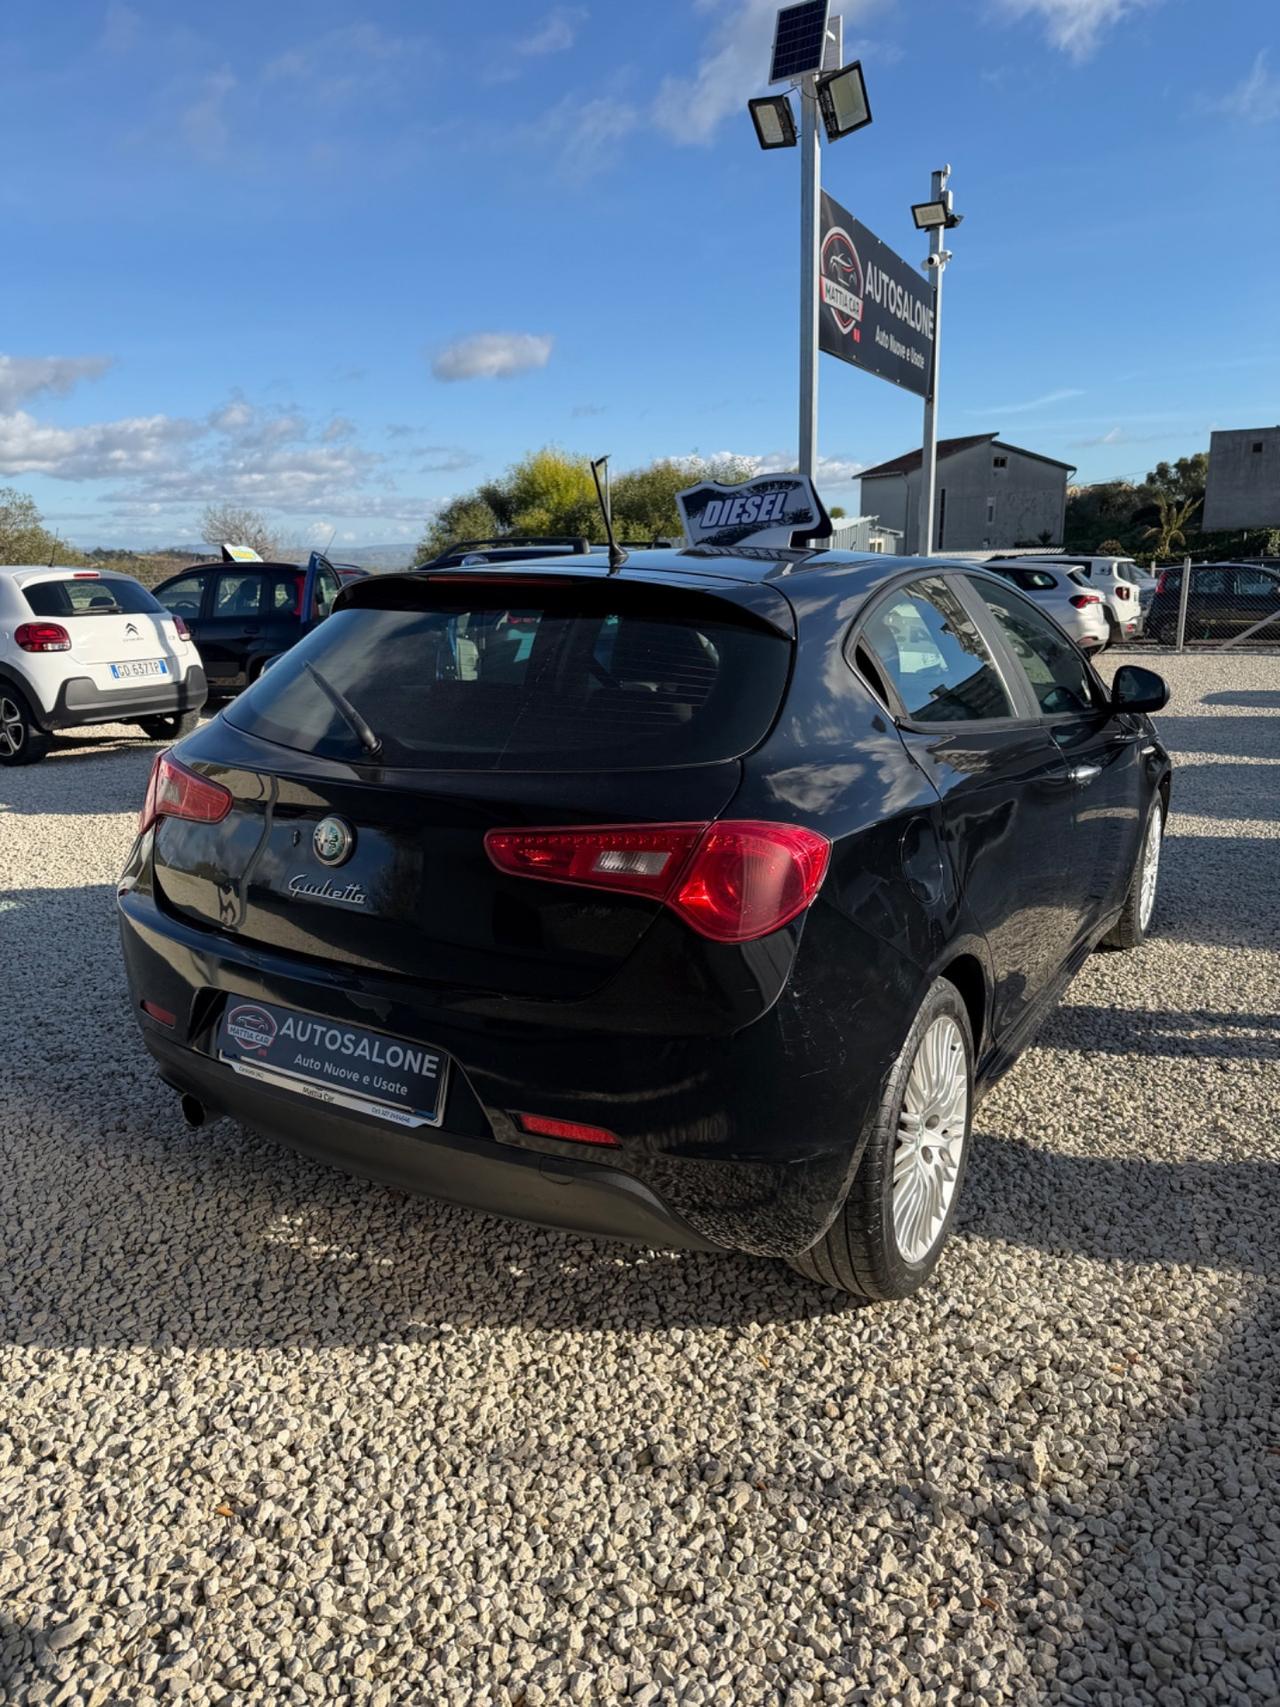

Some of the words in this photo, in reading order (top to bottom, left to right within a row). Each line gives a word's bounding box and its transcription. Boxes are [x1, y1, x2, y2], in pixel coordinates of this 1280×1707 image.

[826, 284, 848, 308] MATTIA
[865, 261, 934, 341] AUTOSALONE
[875, 325, 889, 350] Auto
[890, 336, 906, 359] Nuove
[911, 347, 925, 369] Usate
[701, 493, 787, 528] DIESEL
[288, 874, 367, 904] Giulietta
[230, 1026, 254, 1040] MATTIA
[280, 1017, 440, 1078] AUTOSALONE
[294, 1053, 321, 1071] Auto
[324, 1061, 360, 1083] Nuove
[362, 1075, 371, 1085] e
[373, 1075, 408, 1096] Usate
